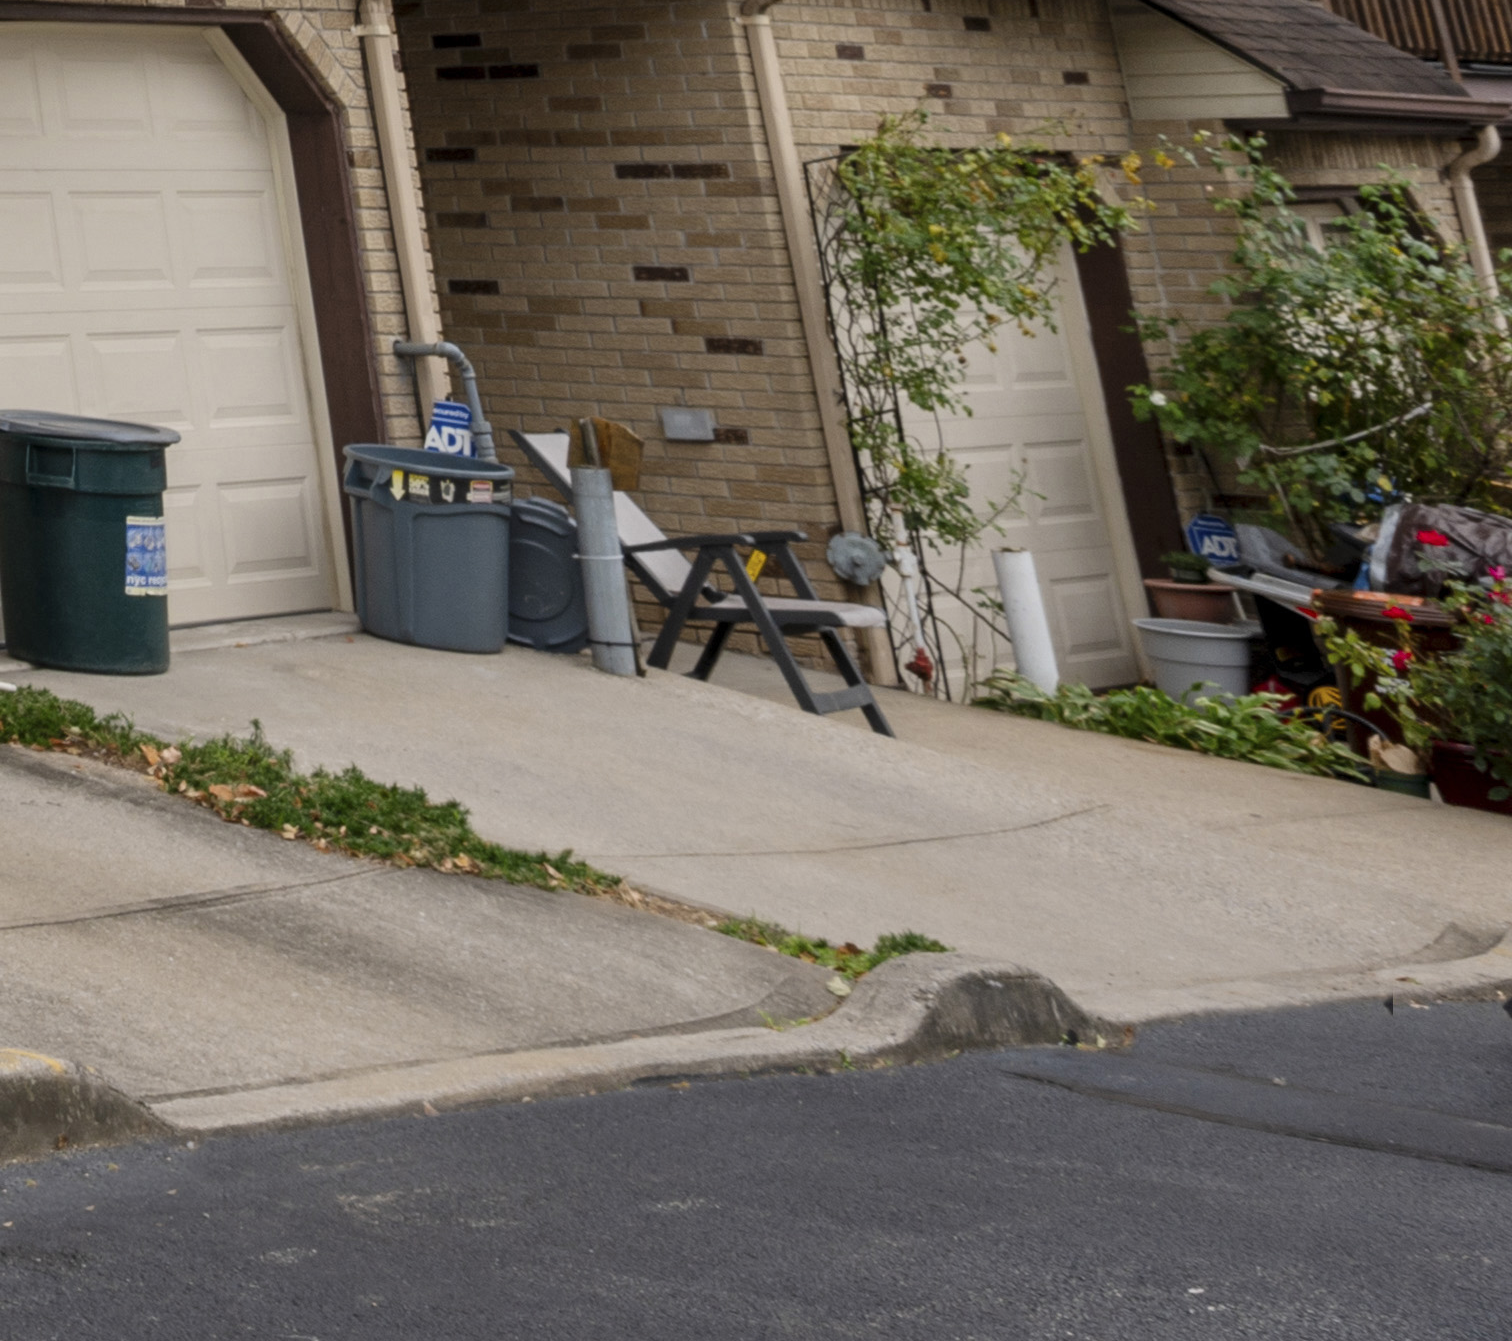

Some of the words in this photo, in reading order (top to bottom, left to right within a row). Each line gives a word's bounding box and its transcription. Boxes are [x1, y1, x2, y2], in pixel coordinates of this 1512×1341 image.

[424, 425, 474, 456] ADT
[1201, 535, 1237, 558] ADT
[126, 575, 146, 587] nyc
